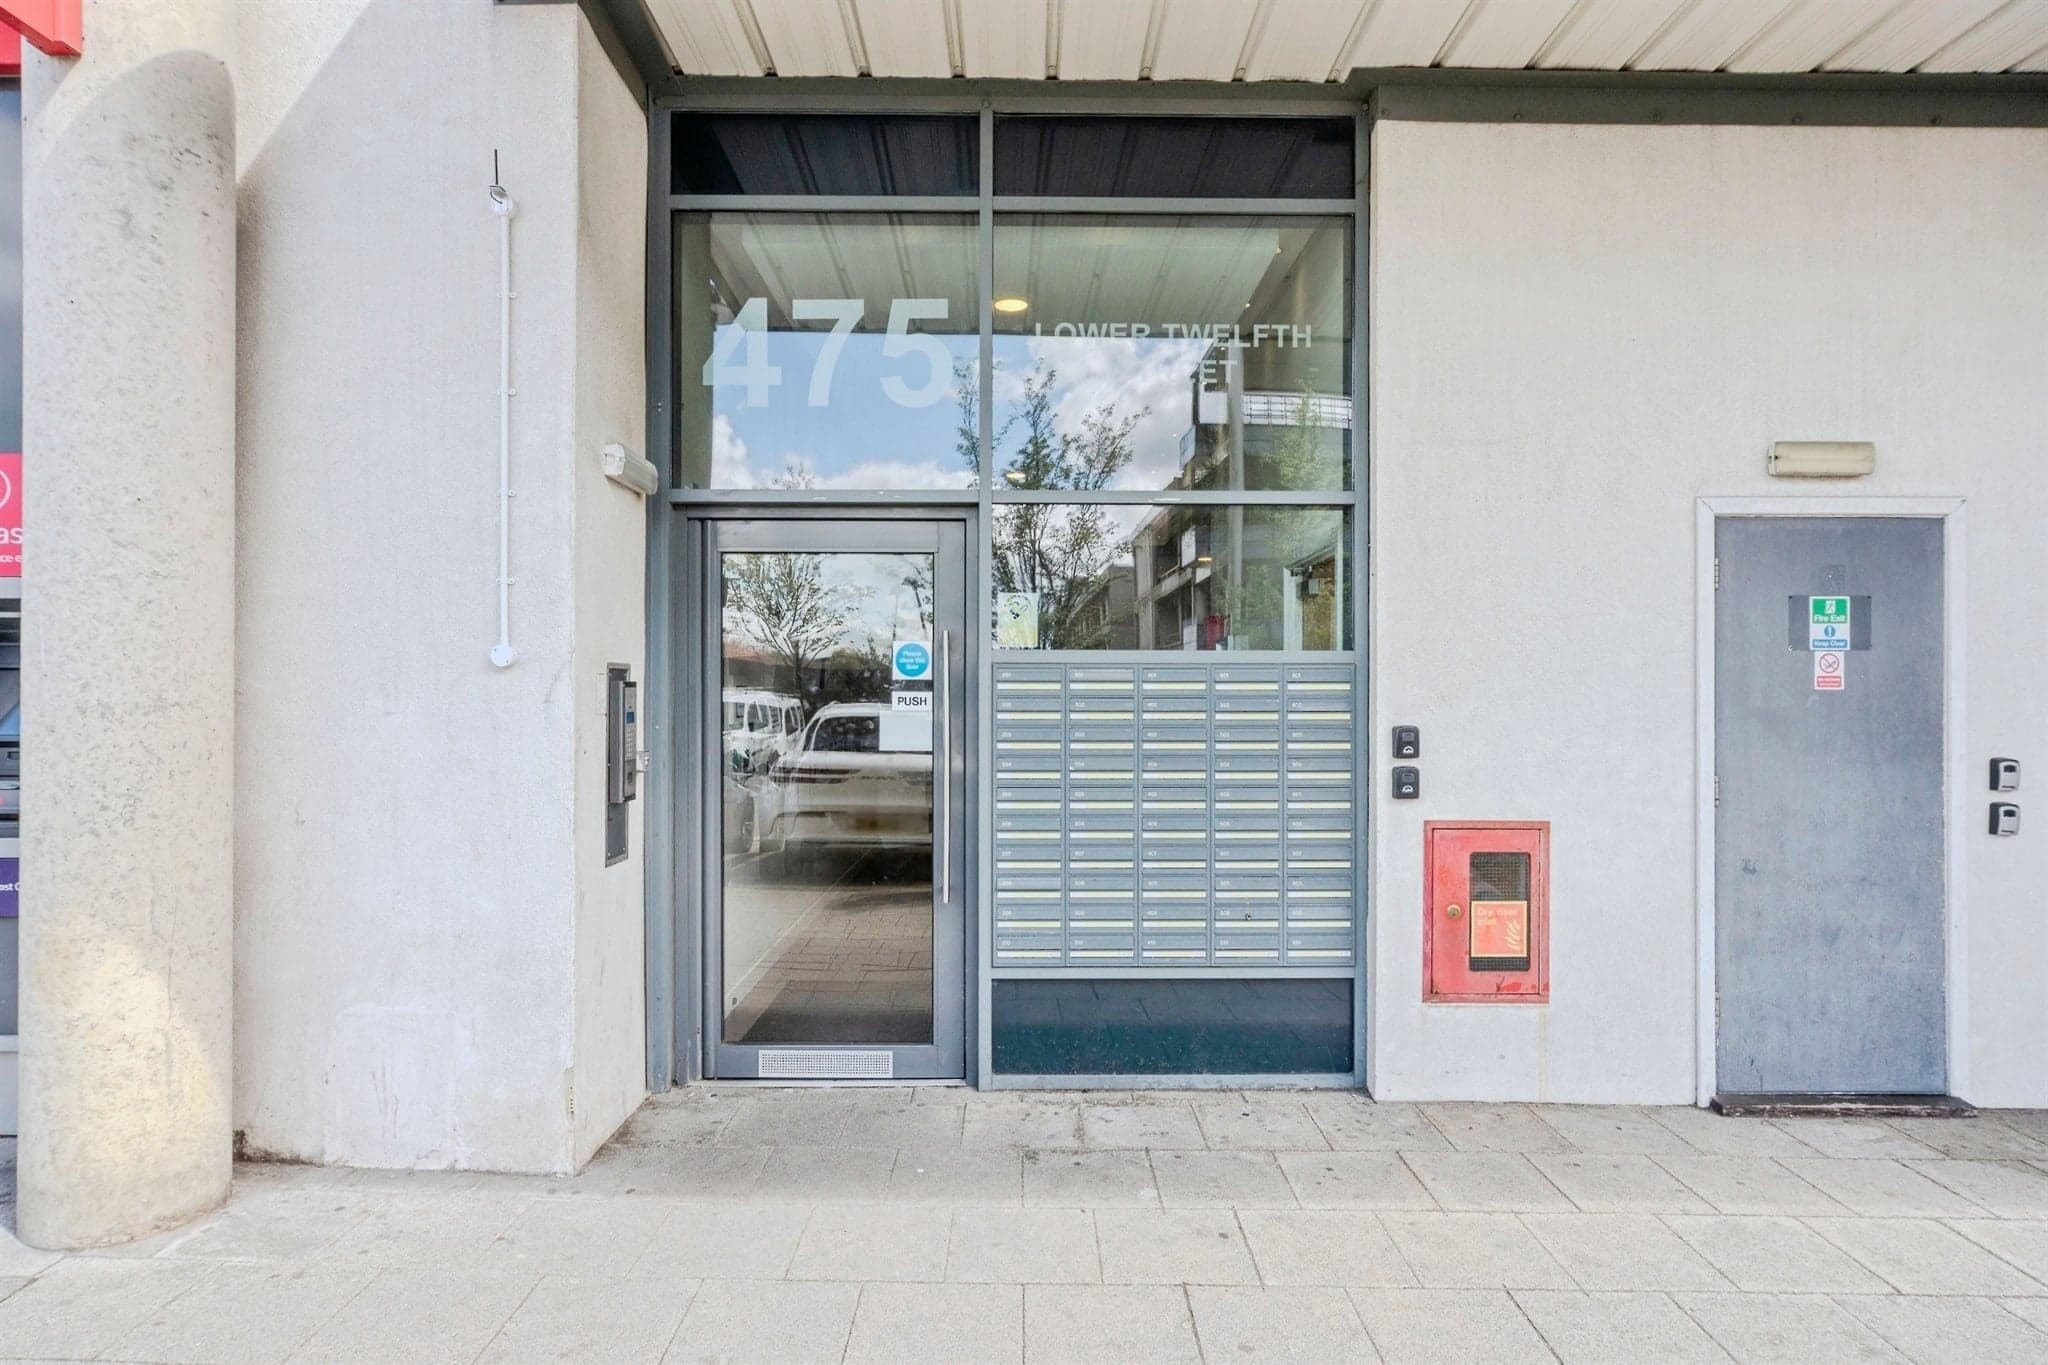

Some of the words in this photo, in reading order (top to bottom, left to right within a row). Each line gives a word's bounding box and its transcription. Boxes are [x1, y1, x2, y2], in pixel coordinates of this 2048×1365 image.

[1161, 323, 1312, 349] TWELFTH
[702, 297, 953, 408] 475
[897, 696, 927, 706] PUSH
